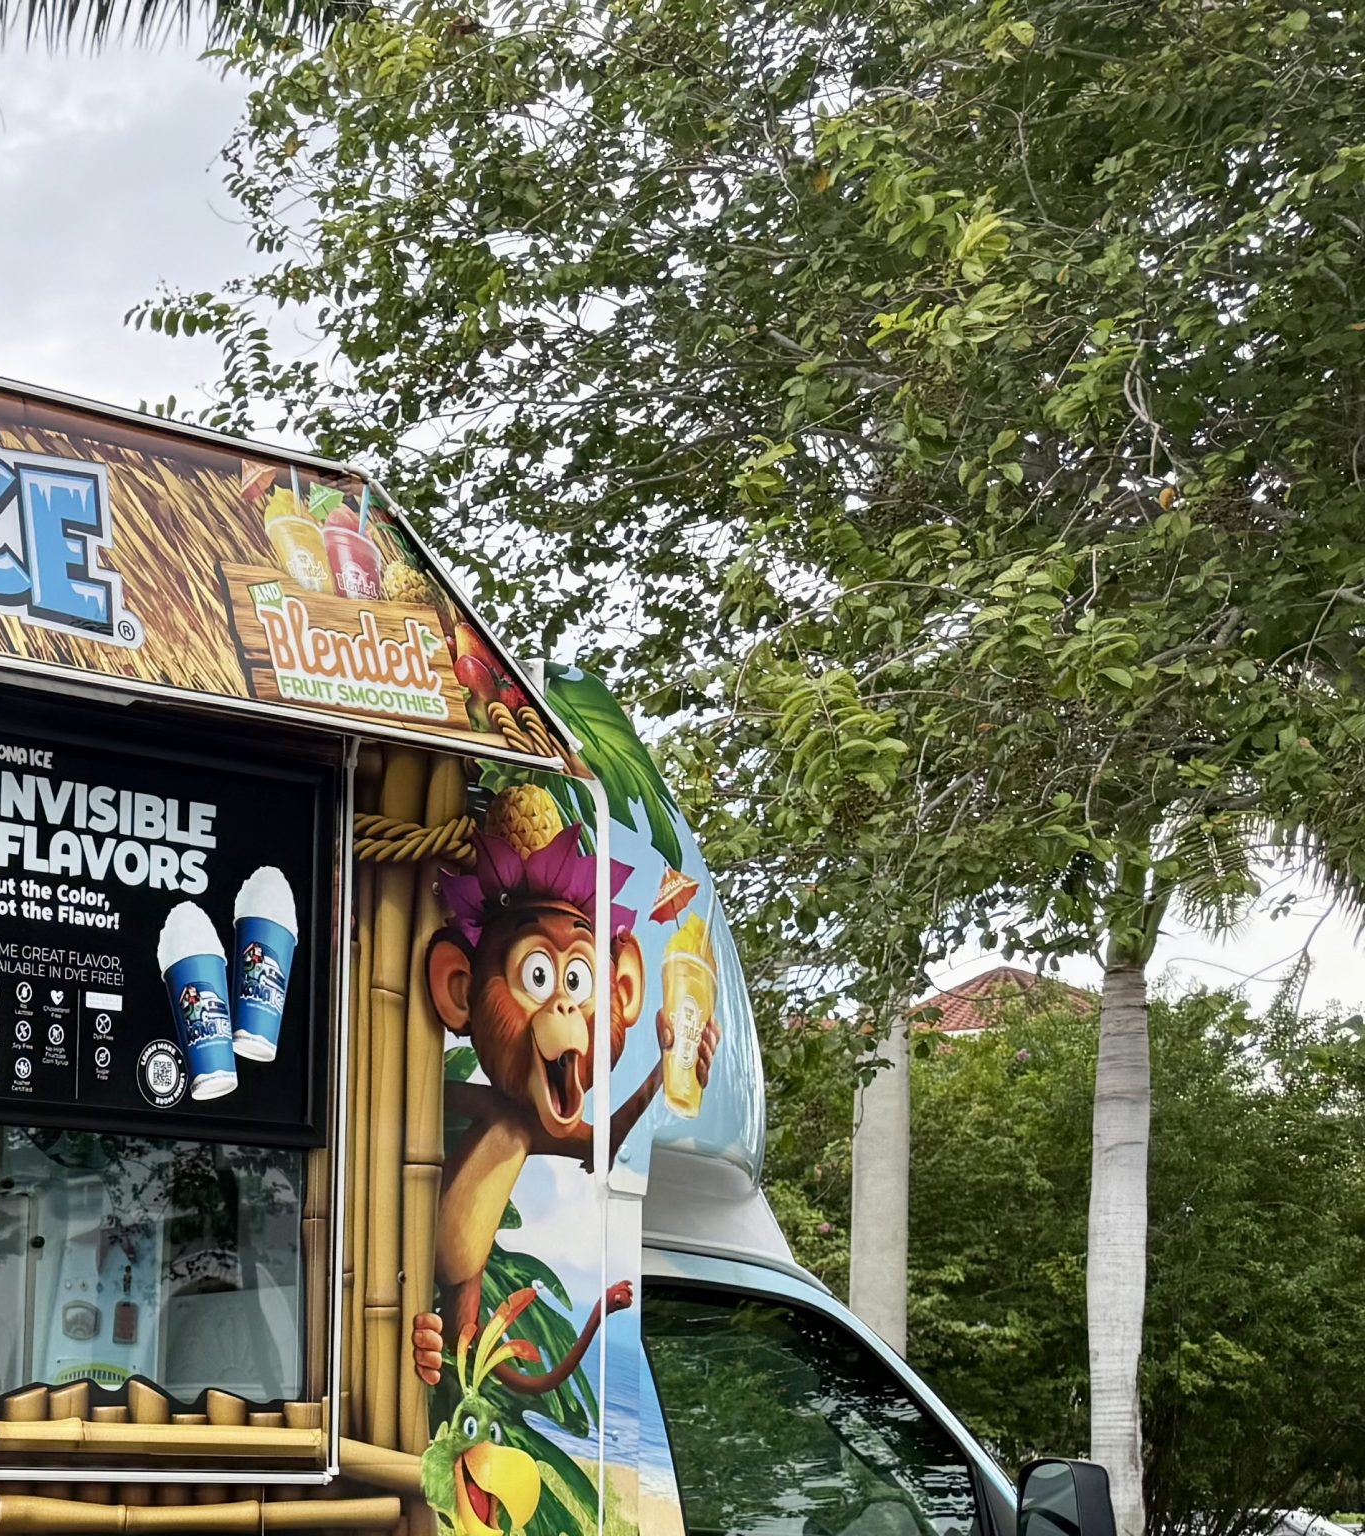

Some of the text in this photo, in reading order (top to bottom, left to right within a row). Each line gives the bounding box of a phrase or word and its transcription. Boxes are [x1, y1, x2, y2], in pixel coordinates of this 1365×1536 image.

[253, 582, 282, 603] AND
[261, 598, 437, 691] Blended
[280, 675, 445, 716] FRUIT SMOOTHIES
[29, 748, 53, 769] ICE
[20, 879, 51, 901] the
[56, 884, 111, 911] Color,
[22, 899, 53, 921] the
[57, 903, 120, 930] Flavor!
[21, 946, 66, 963] GREAT
[69, 951, 122, 972] FLAVOR,
[49, 966, 61, 979] IN
[65, 967, 88, 982] DYE
[91, 971, 124, 986] FREE!
[140, 1043, 157, 1066] LEARN
[157, 1042, 176, 1055] MORE
